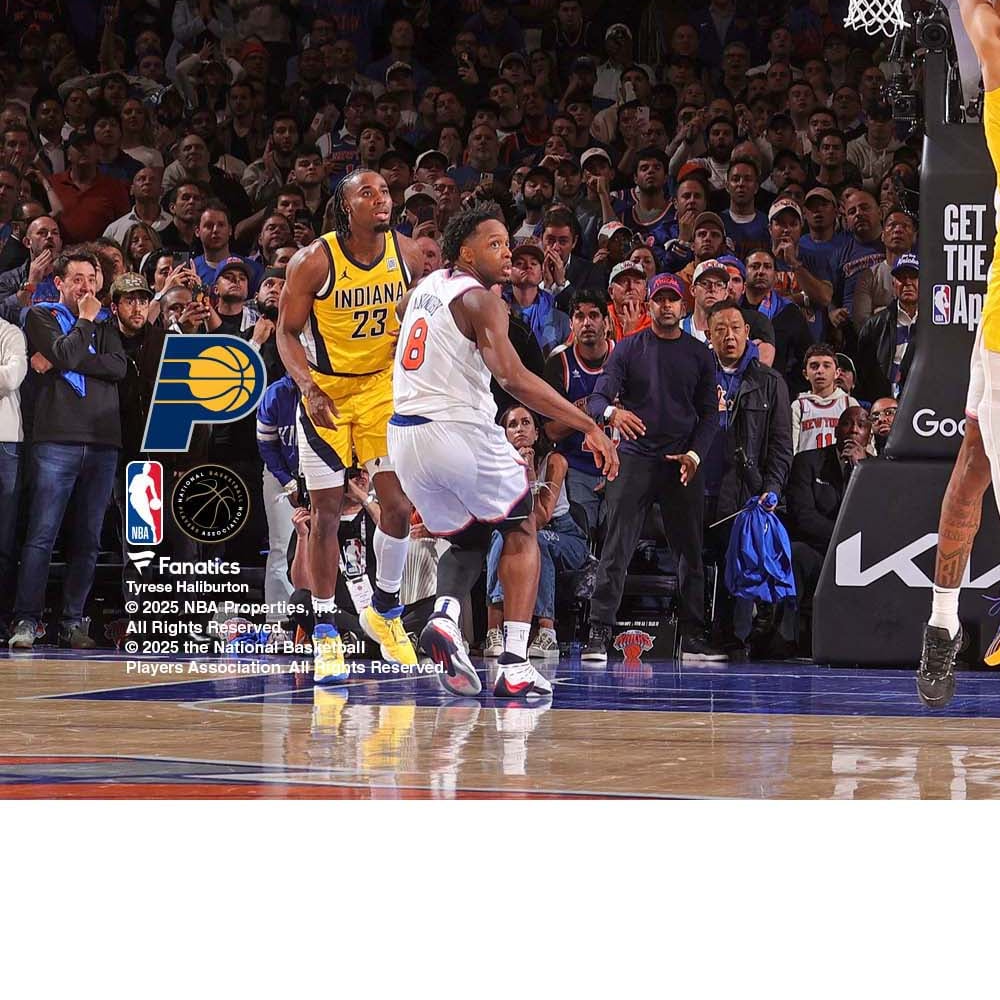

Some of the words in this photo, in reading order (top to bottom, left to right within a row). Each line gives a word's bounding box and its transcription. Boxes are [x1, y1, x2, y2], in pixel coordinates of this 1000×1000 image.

[944, 204, 987, 241] GET
[943, 244, 987, 282] THE
[334, 280, 403, 309] INDIANA
[953, 285, 984, 332] Ap
[351, 308, 388, 339] 23
[401, 317, 429, 371] 8
